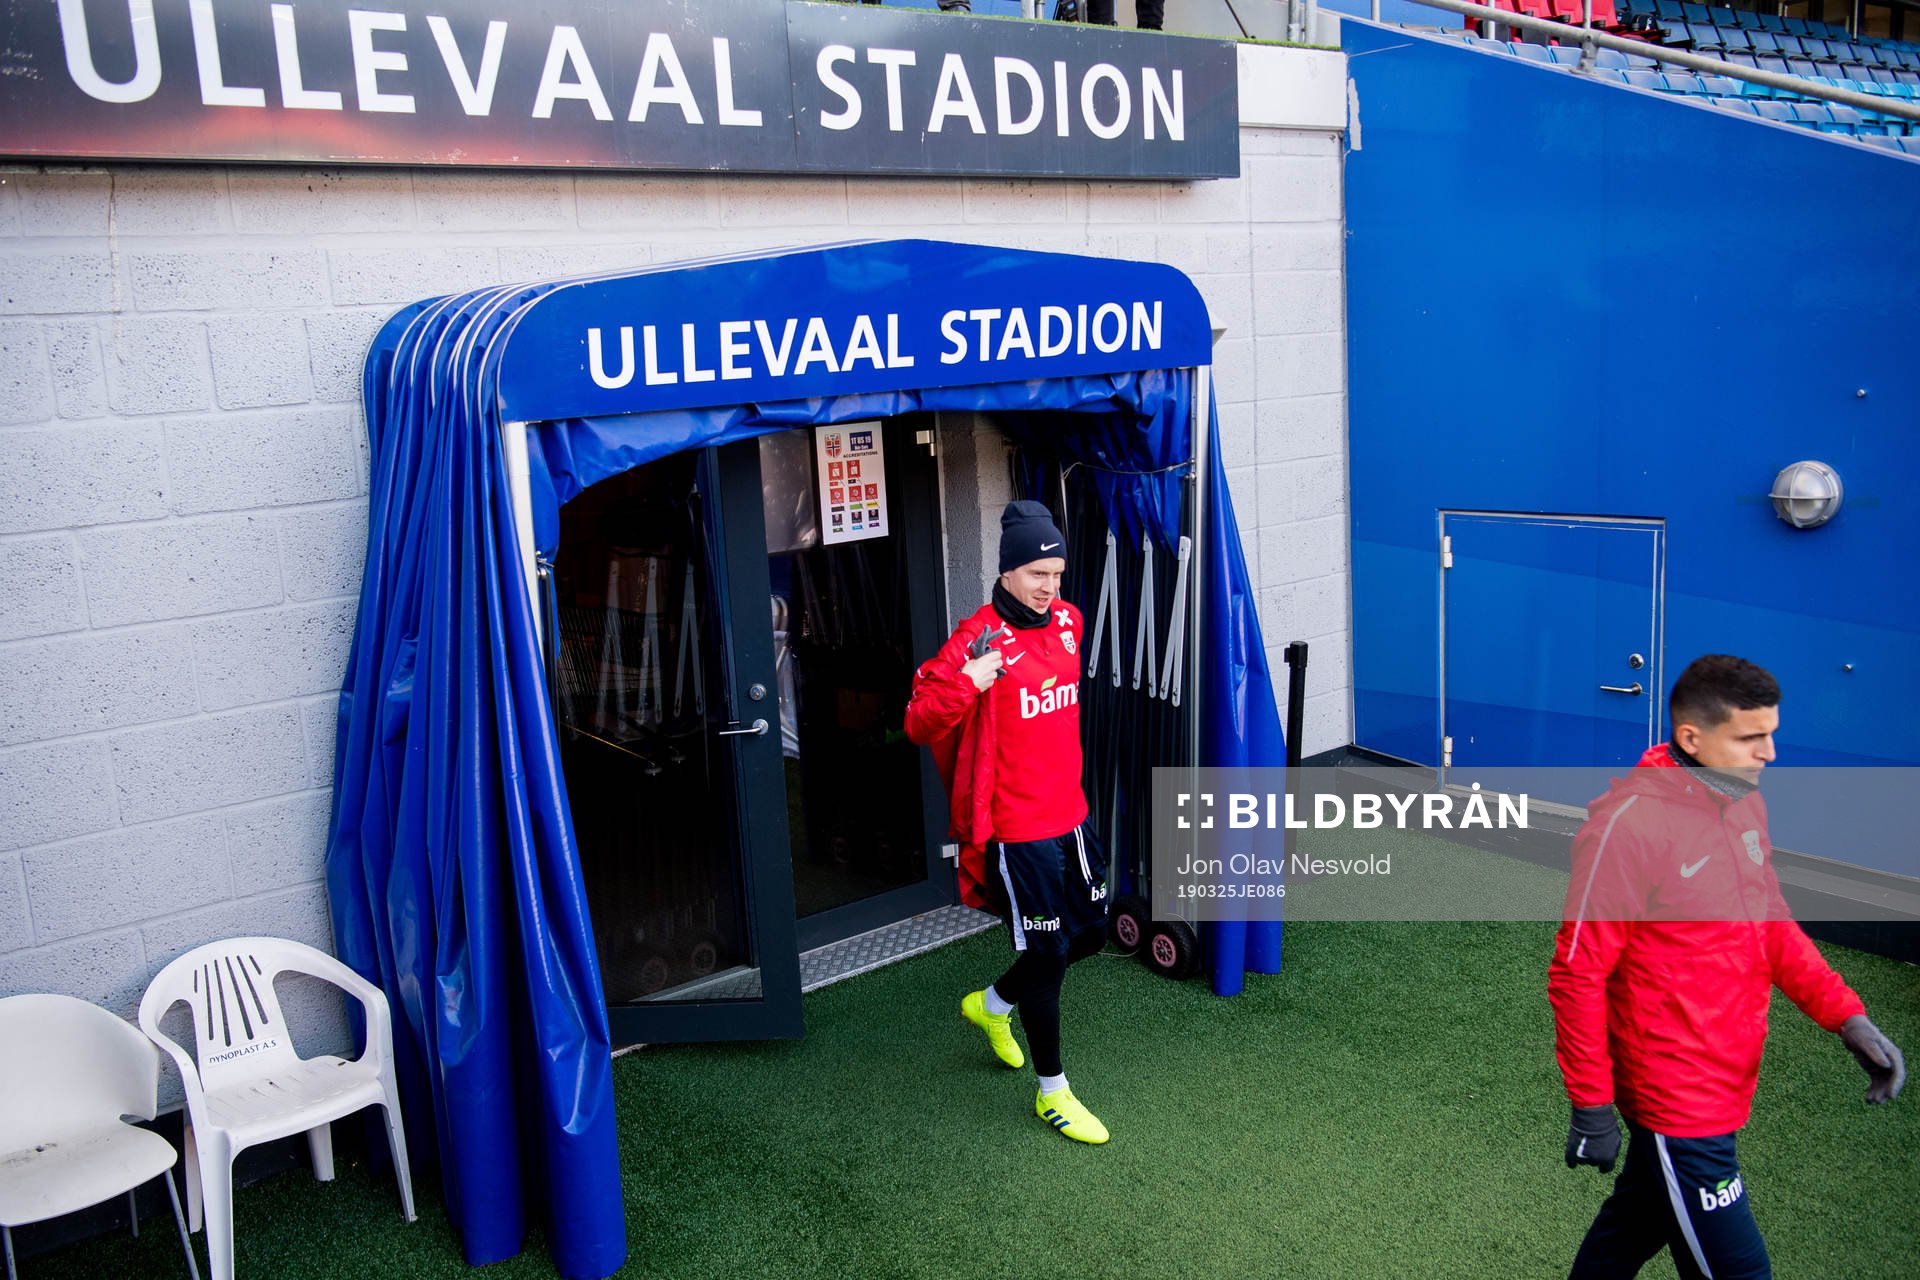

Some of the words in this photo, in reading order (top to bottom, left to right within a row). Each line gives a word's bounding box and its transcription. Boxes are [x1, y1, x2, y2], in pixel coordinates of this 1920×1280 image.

[59, 0, 763, 127] ULLEVAAL
[816, 43, 1185, 142] STADION
[587, 313, 915, 389] ULLEVAAL
[939, 301, 1163, 366] STADION
[1020, 681, 1080, 719] bam
[209, 1044, 259, 1063] DYNOPLAST
[1698, 1173, 1743, 1211] bam
